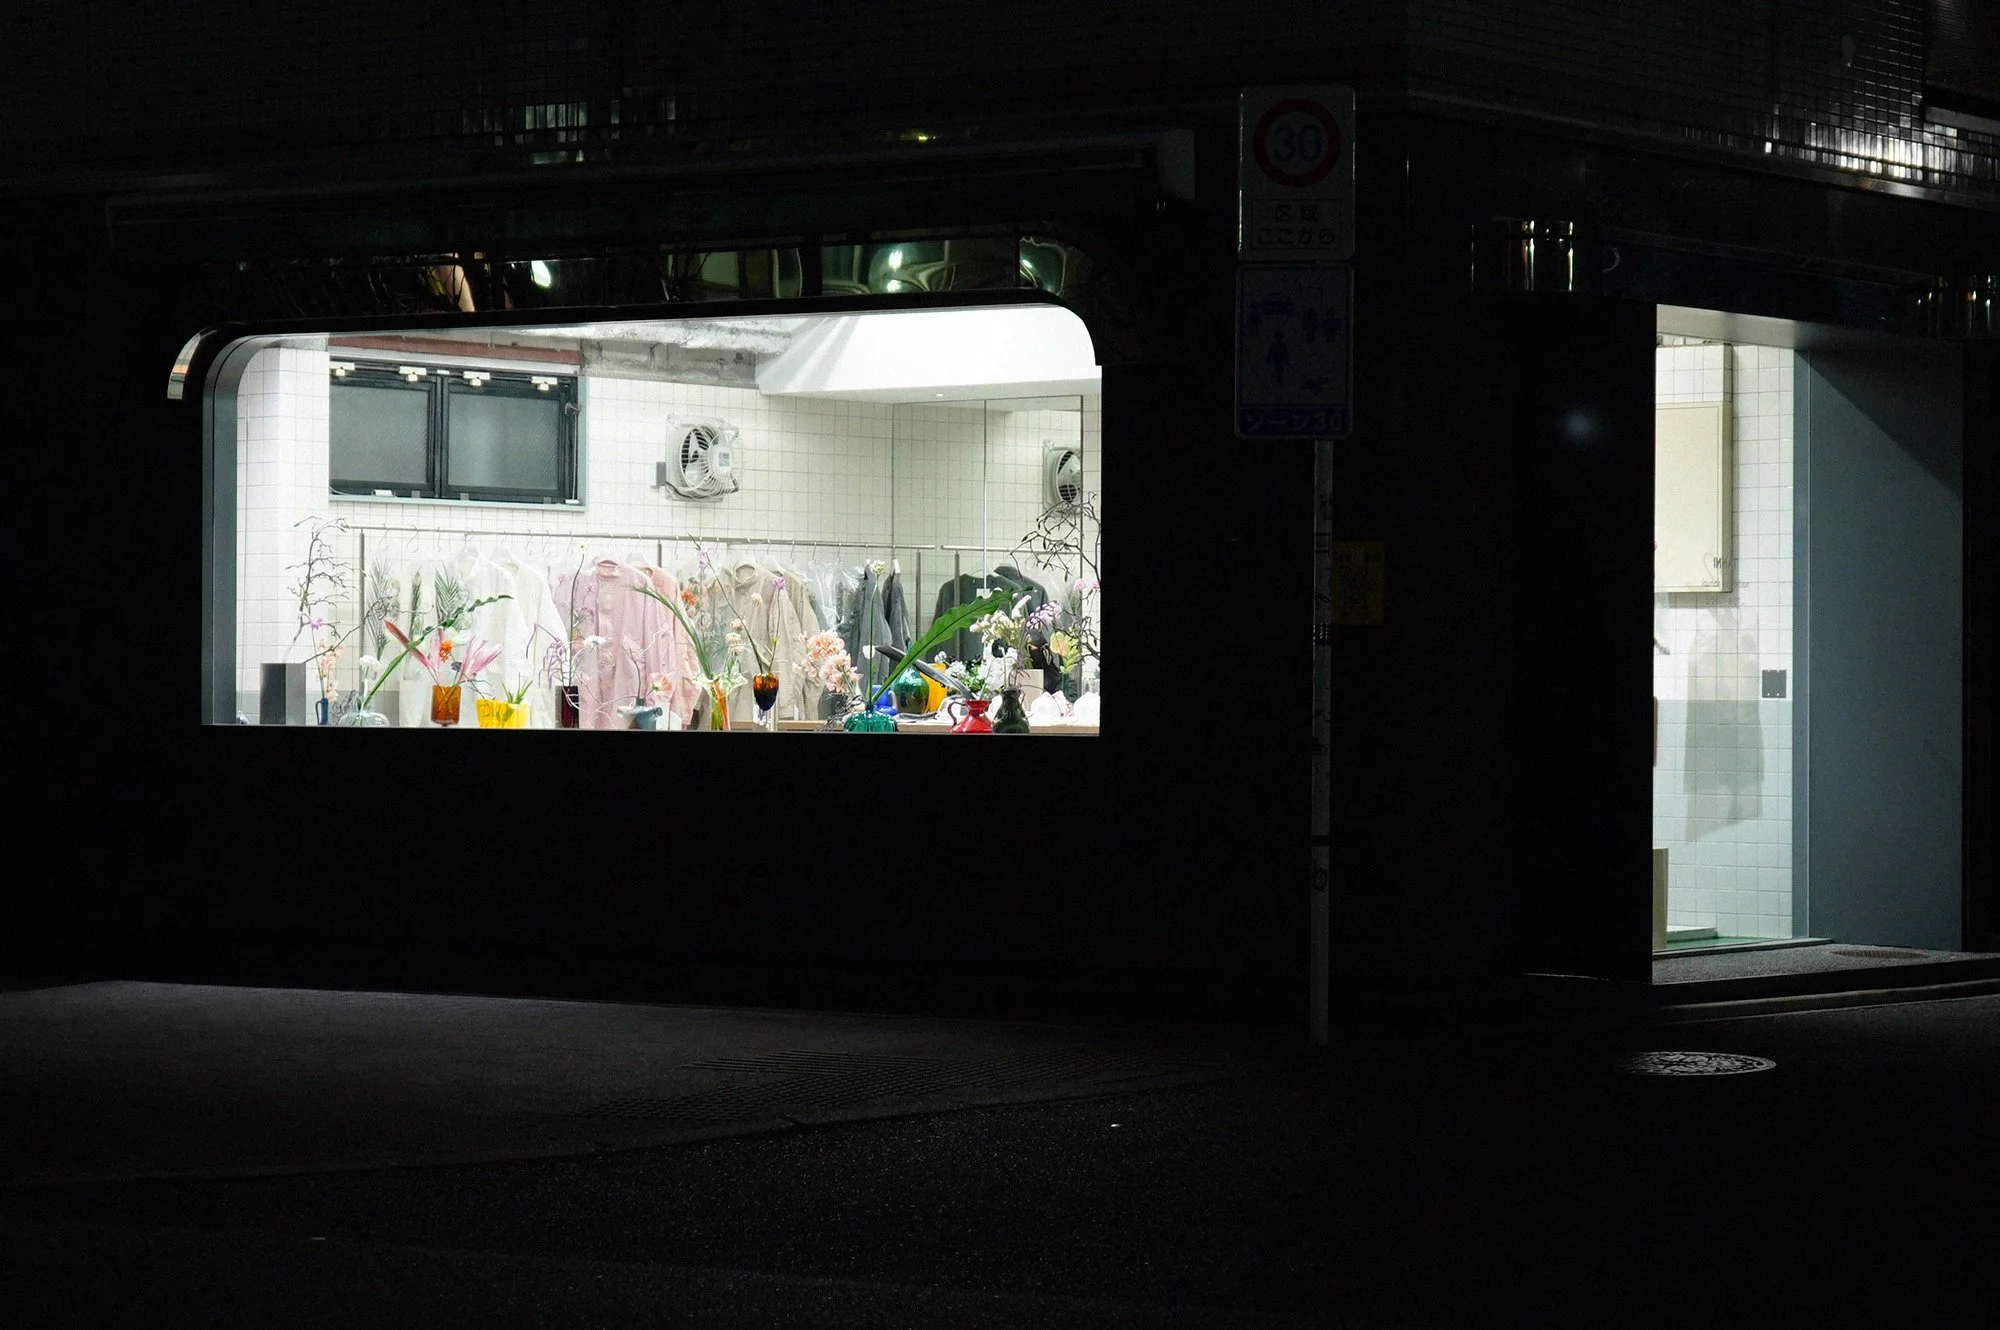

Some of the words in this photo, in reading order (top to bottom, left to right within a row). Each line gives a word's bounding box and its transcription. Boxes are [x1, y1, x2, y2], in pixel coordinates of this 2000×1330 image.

[1274, 124, 1322, 162] 30
[1257, 227, 1335, 245] ここから
